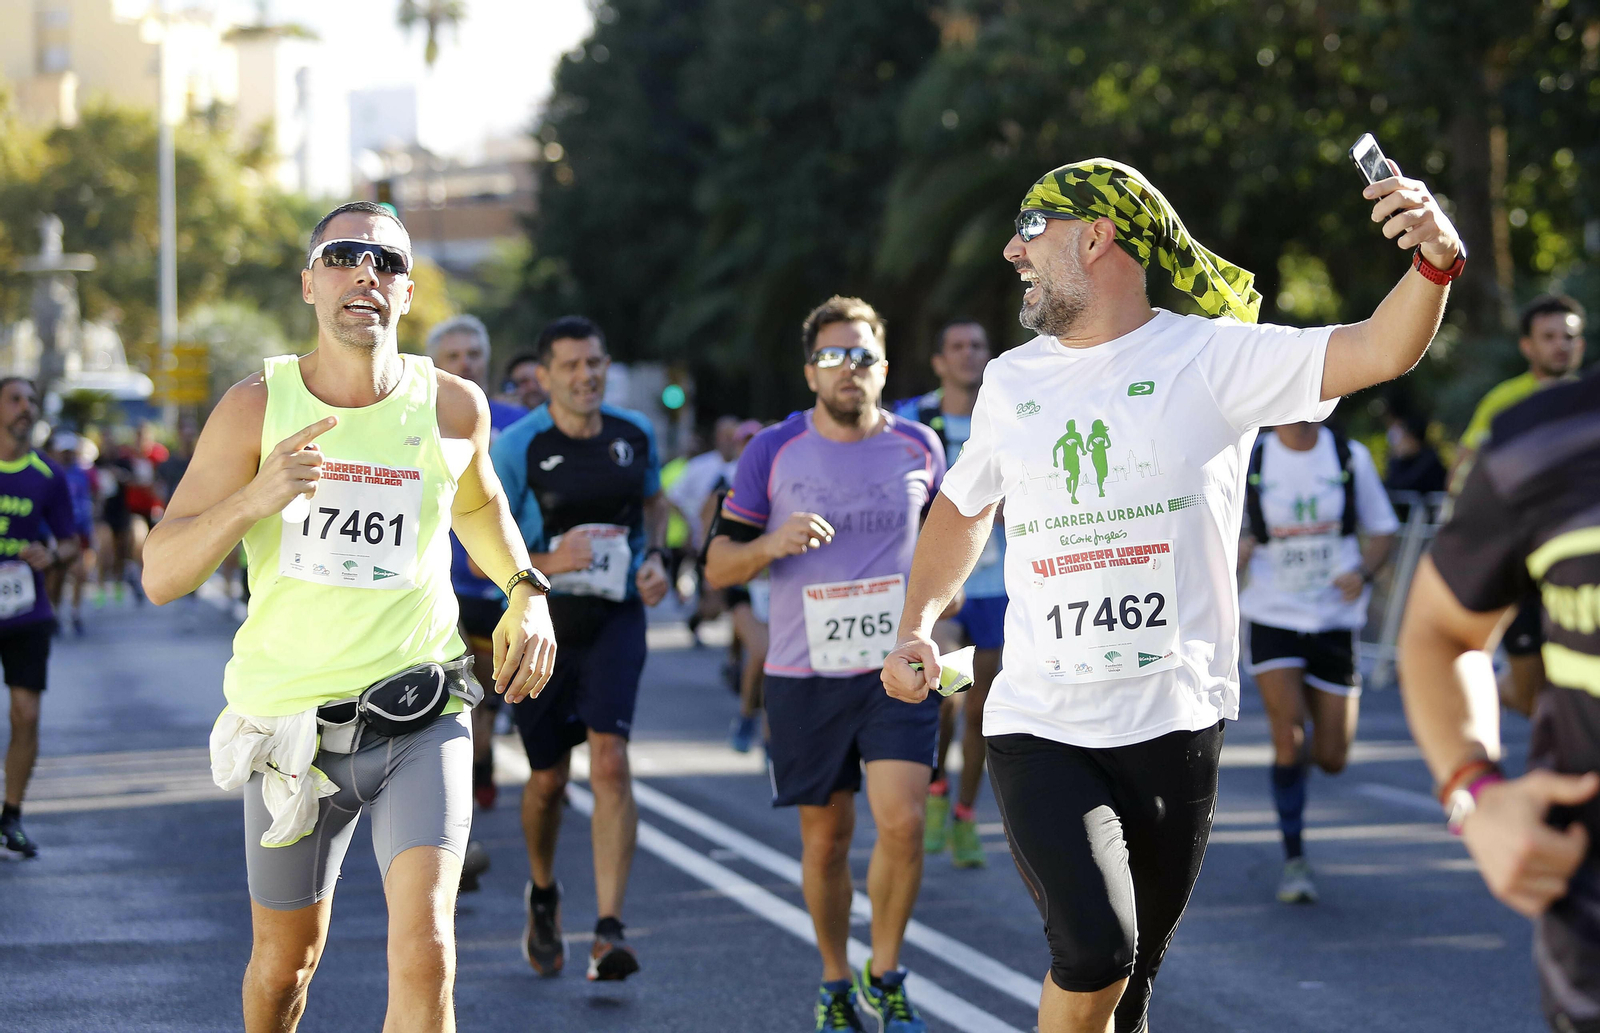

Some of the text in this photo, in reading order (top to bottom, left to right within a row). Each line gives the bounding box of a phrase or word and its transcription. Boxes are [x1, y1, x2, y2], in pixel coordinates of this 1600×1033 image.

[374, 467, 420, 480] URBANA
[1028, 502, 1165, 534] 41 CARRERA URBANA
[1060, 529, 1128, 546] El Corte Inglés
[1031, 543, 1170, 578] 41 CARRERA URBANA
[1058, 562, 1093, 575] CIUDAD
[1094, 560, 1107, 569] DE
[825, 612, 893, 641] 2765
[1047, 592, 1167, 639] 17462
